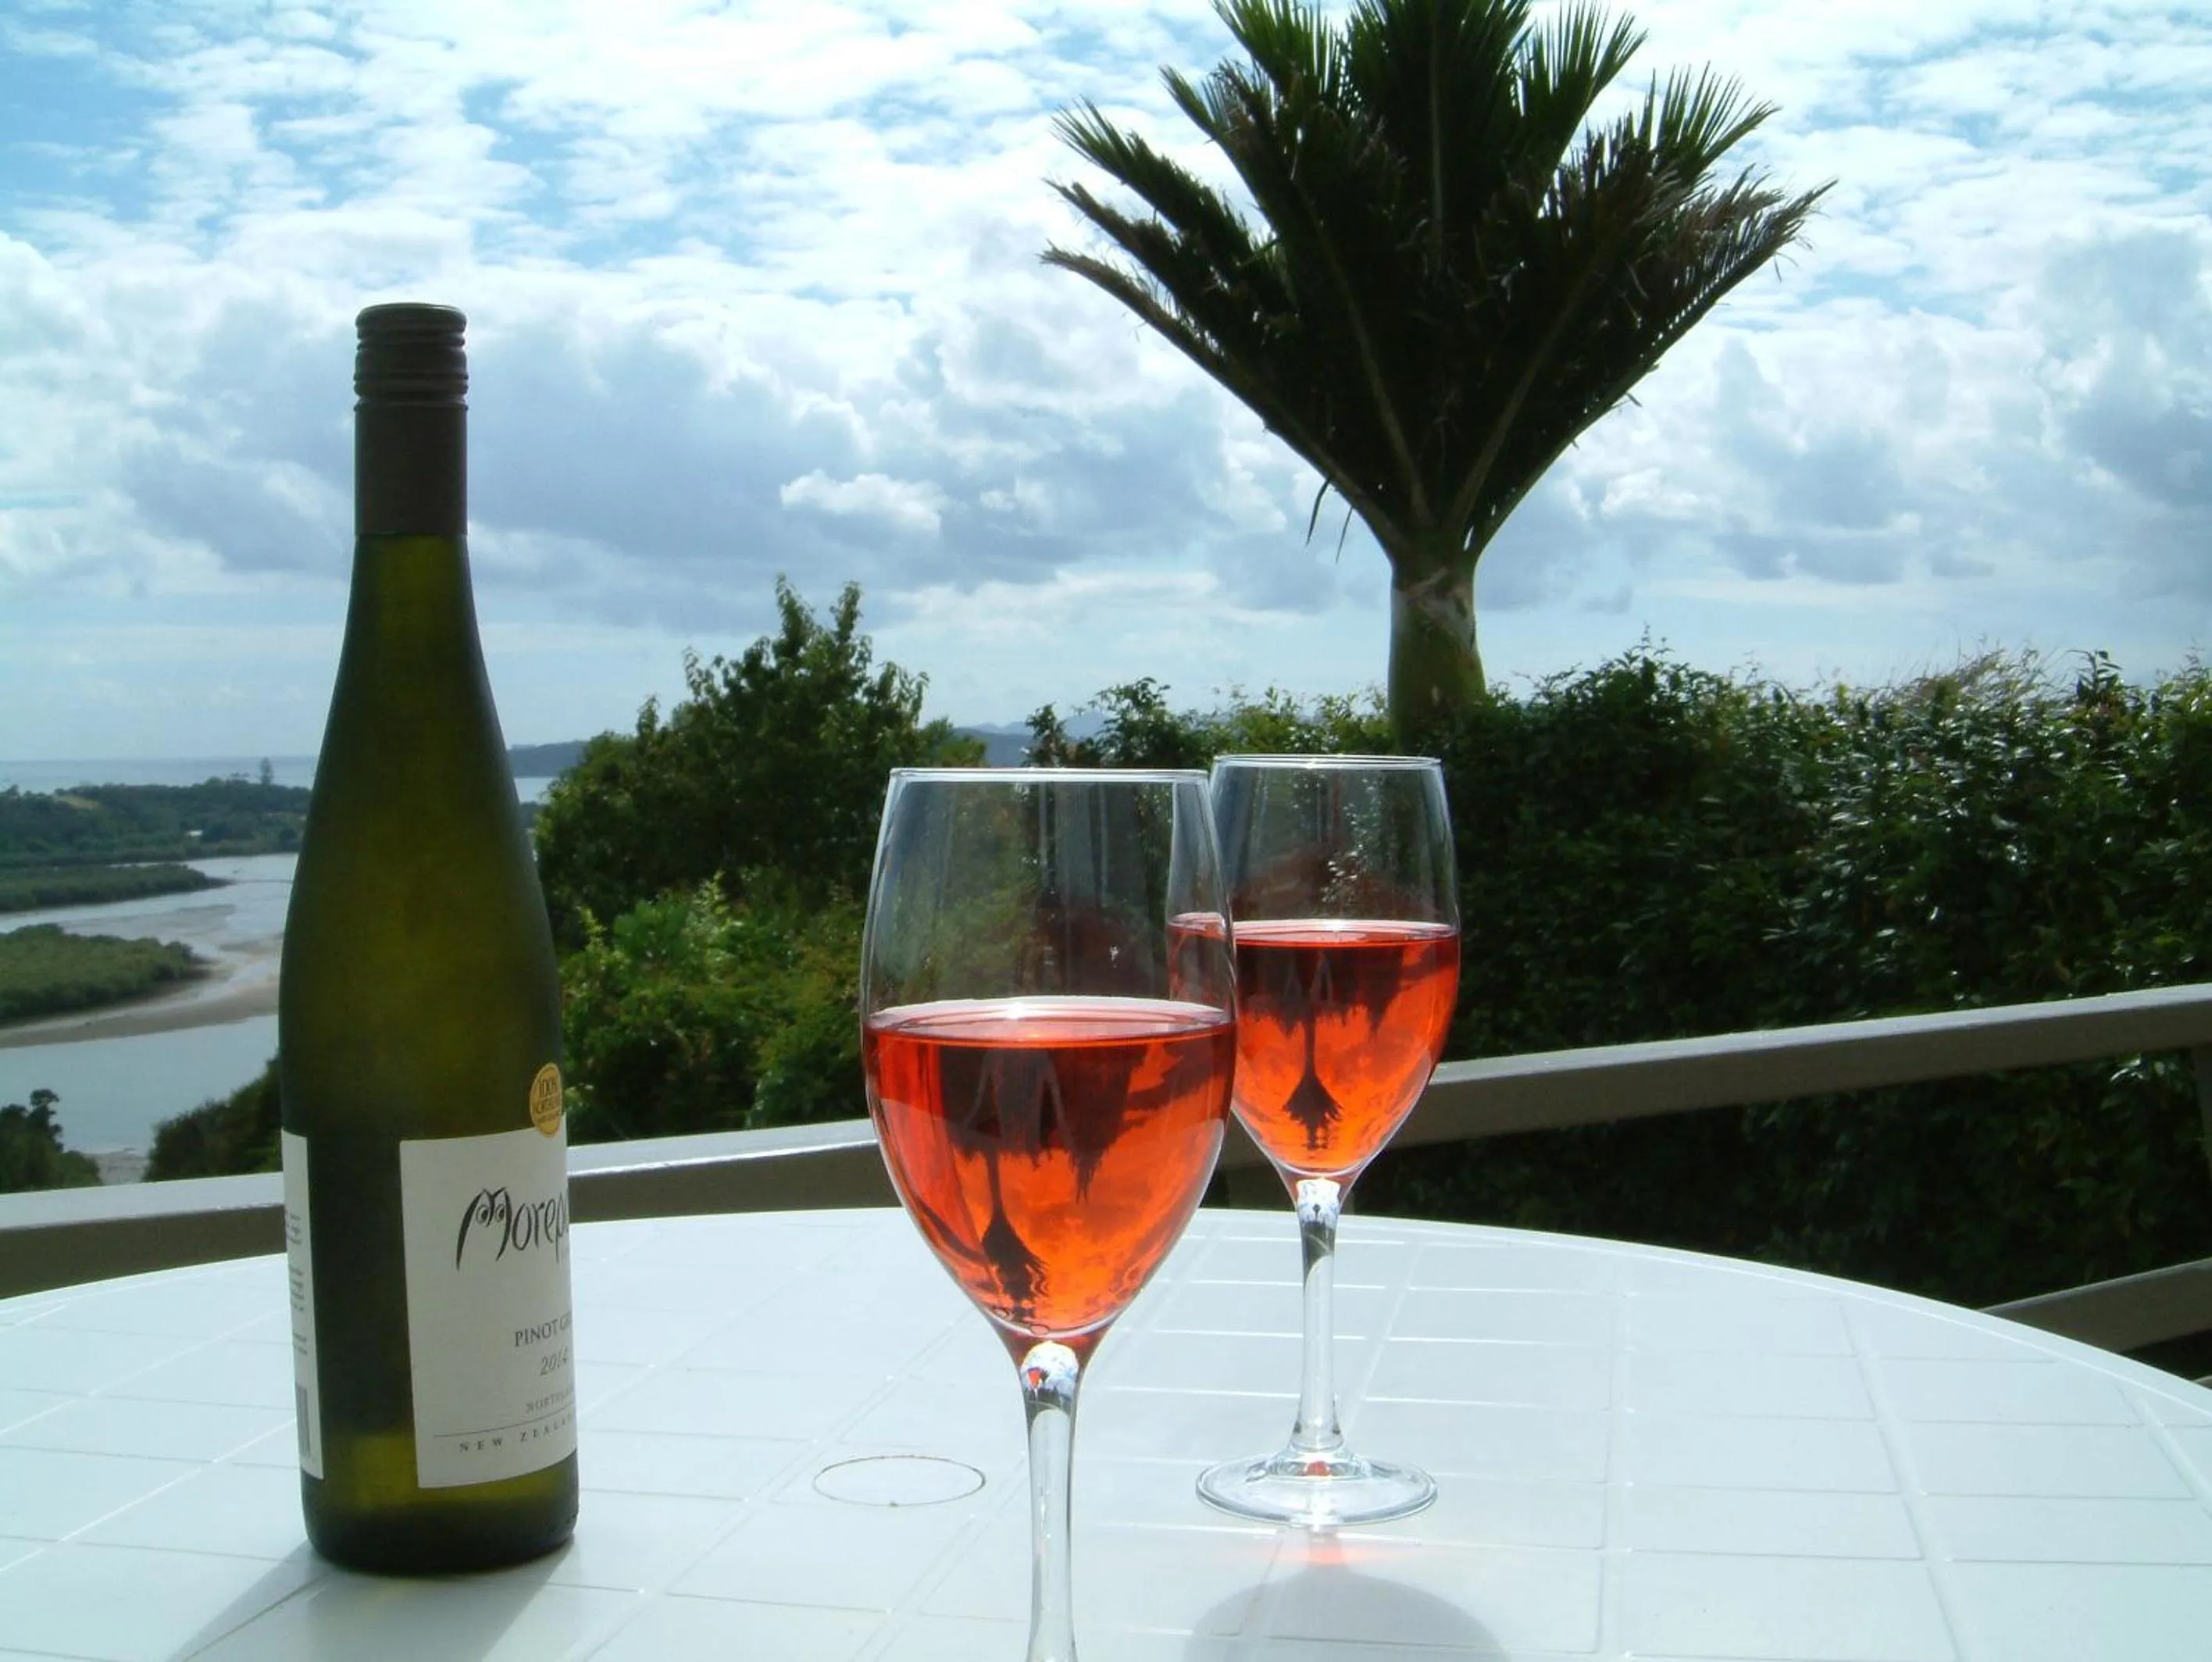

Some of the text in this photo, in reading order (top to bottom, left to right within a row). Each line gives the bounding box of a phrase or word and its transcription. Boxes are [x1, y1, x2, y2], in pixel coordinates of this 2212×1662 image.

[456, 1186, 569, 1271] Morep
[513, 1318, 558, 1347] PINOT
[540, 1346, 567, 1376] 2014
[458, 1437, 502, 1453] NEW
